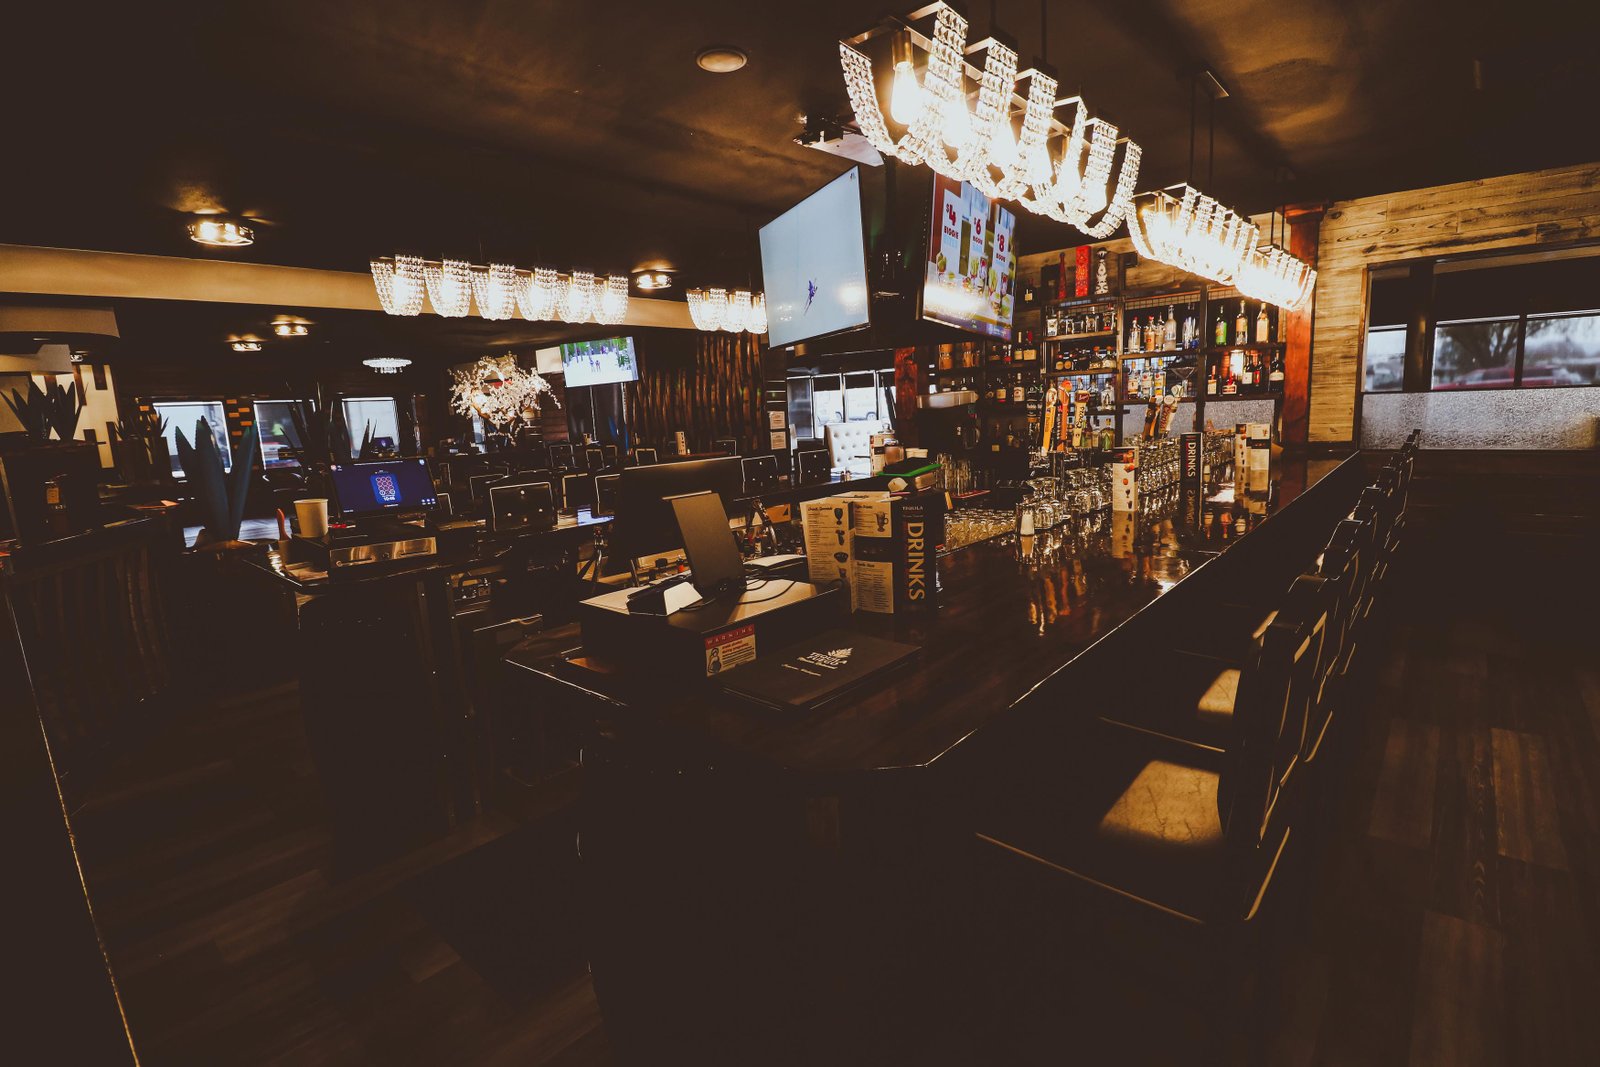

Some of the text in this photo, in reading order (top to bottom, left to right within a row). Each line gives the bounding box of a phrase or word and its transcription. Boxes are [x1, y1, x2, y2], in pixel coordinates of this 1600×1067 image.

[945, 203, 957, 226] $4
[943, 226, 959, 240] BIGGIE
[973, 217, 982, 235] $6
[997, 233, 1005, 253] $8
[1188, 442, 1197, 477] DRINKS
[907, 521, 925, 602] DRINKS
[707, 626, 753, 645] WARNING
